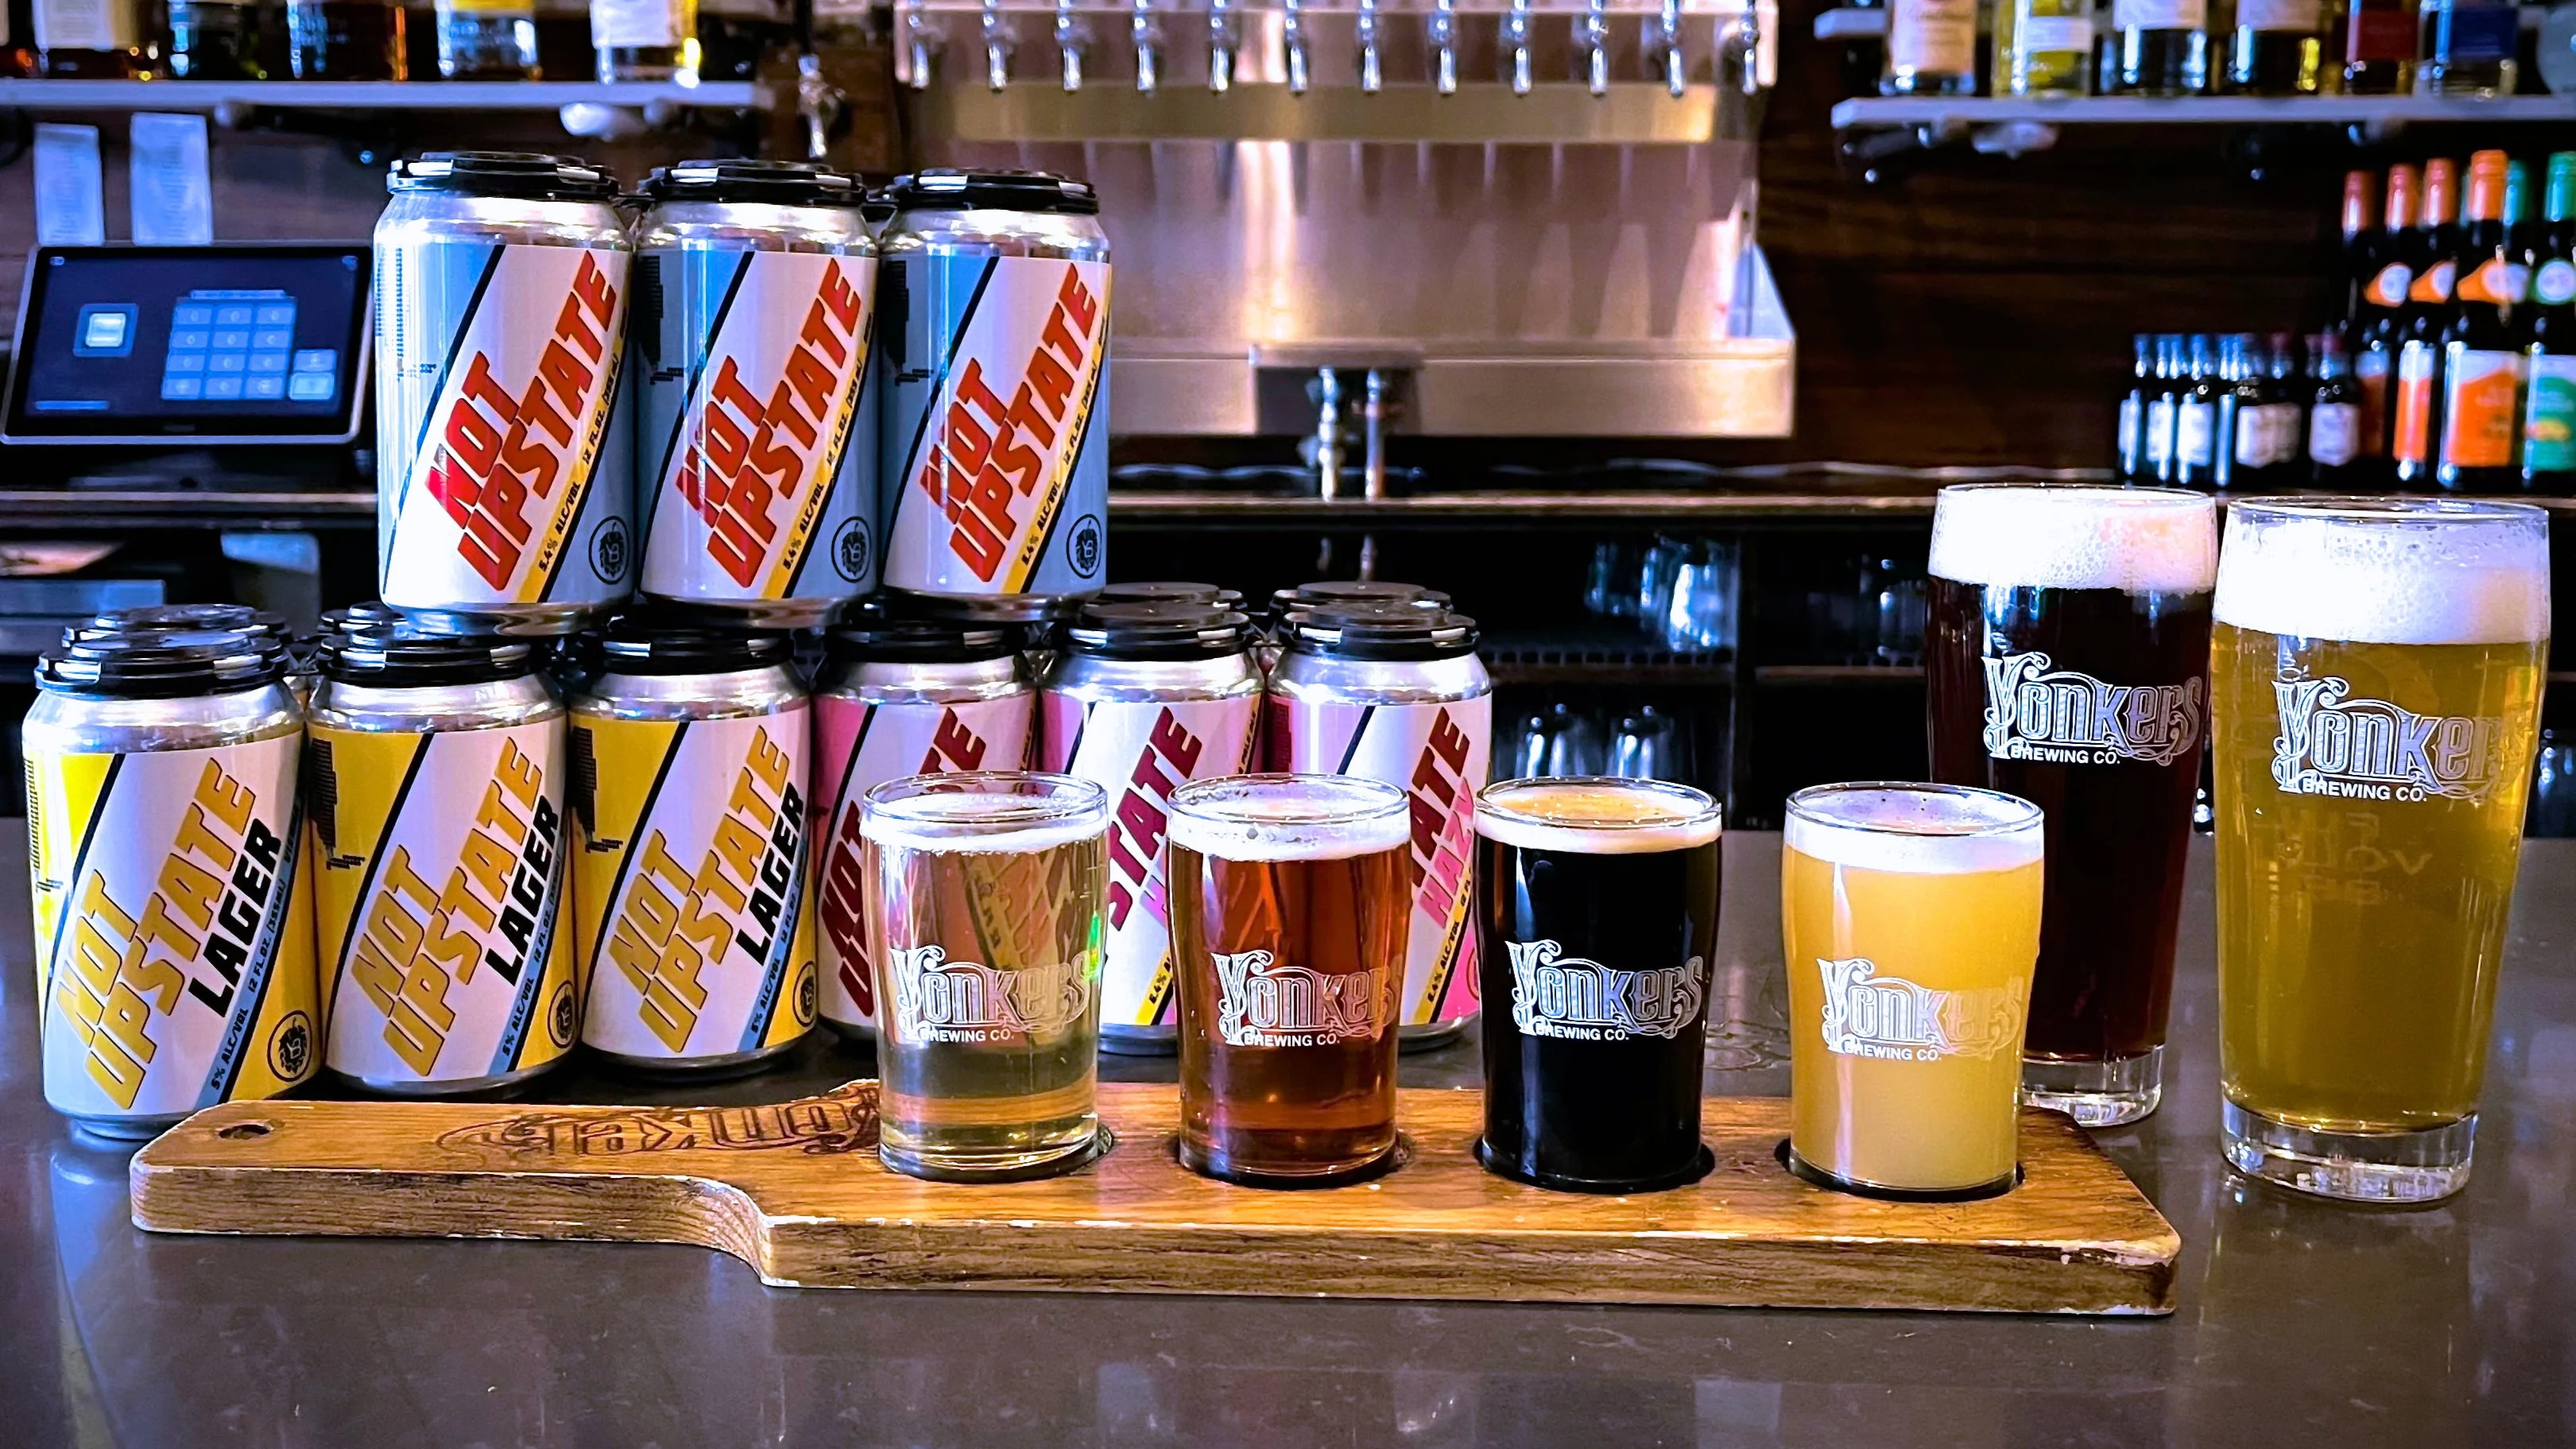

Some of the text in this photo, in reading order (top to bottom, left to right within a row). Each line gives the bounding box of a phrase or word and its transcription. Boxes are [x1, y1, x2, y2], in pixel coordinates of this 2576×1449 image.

[424, 351, 519, 529] NOT
[458, 250, 616, 591] UPSTATE
[675, 355, 766, 528] NOT
[707, 257, 862, 588] UPSTATE
[920, 357, 1008, 525] NOT
[949, 262, 1097, 583] UPSTATE
[555, 481, 581, 535] ALC/VOL
[800, 482, 824, 534] ALC/VOL
[1037, 481, 1061, 531] ALC/VOL
[1981, 651, 2202, 766] Yonkers
[2010, 745, 2121, 765] BREWING CO.
[2301, 781, 2427, 802] BREWING CO.
[84, 757, 255, 1110] UPSTATE
[188, 817, 281, 1017] LAGER
[351, 844, 440, 1018] NOT
[383, 736, 543, 1077] UPSTATE
[485, 795, 559, 986] LAGER
[608, 829, 695, 994] NOT
[639, 725, 790, 1053] UPSTATE
[734, 781, 804, 967] LAGER
[56, 869, 138, 1048] NOT
[502, 1035, 514, 1056] 5%
[512, 978, 534, 1032] ALC/VOL
[760, 958, 781, 1009] ALC/VOL
[889, 944, 1090, 1043] Yonkers
[1504, 940, 1704, 1039] Yonkers
[211, 1065, 225, 1090] 5%
[221, 1008, 248, 1065] ALC/VOL
[248, 978, 258, 994] 12
[920, 1028, 1015, 1043] BREWING CO.
[1244, 1033, 1341, 1047] BREWING CO.
[1535, 1025, 1629, 1041] BREWING CO.
[1845, 1044, 1943, 1062] BREWING CO.
